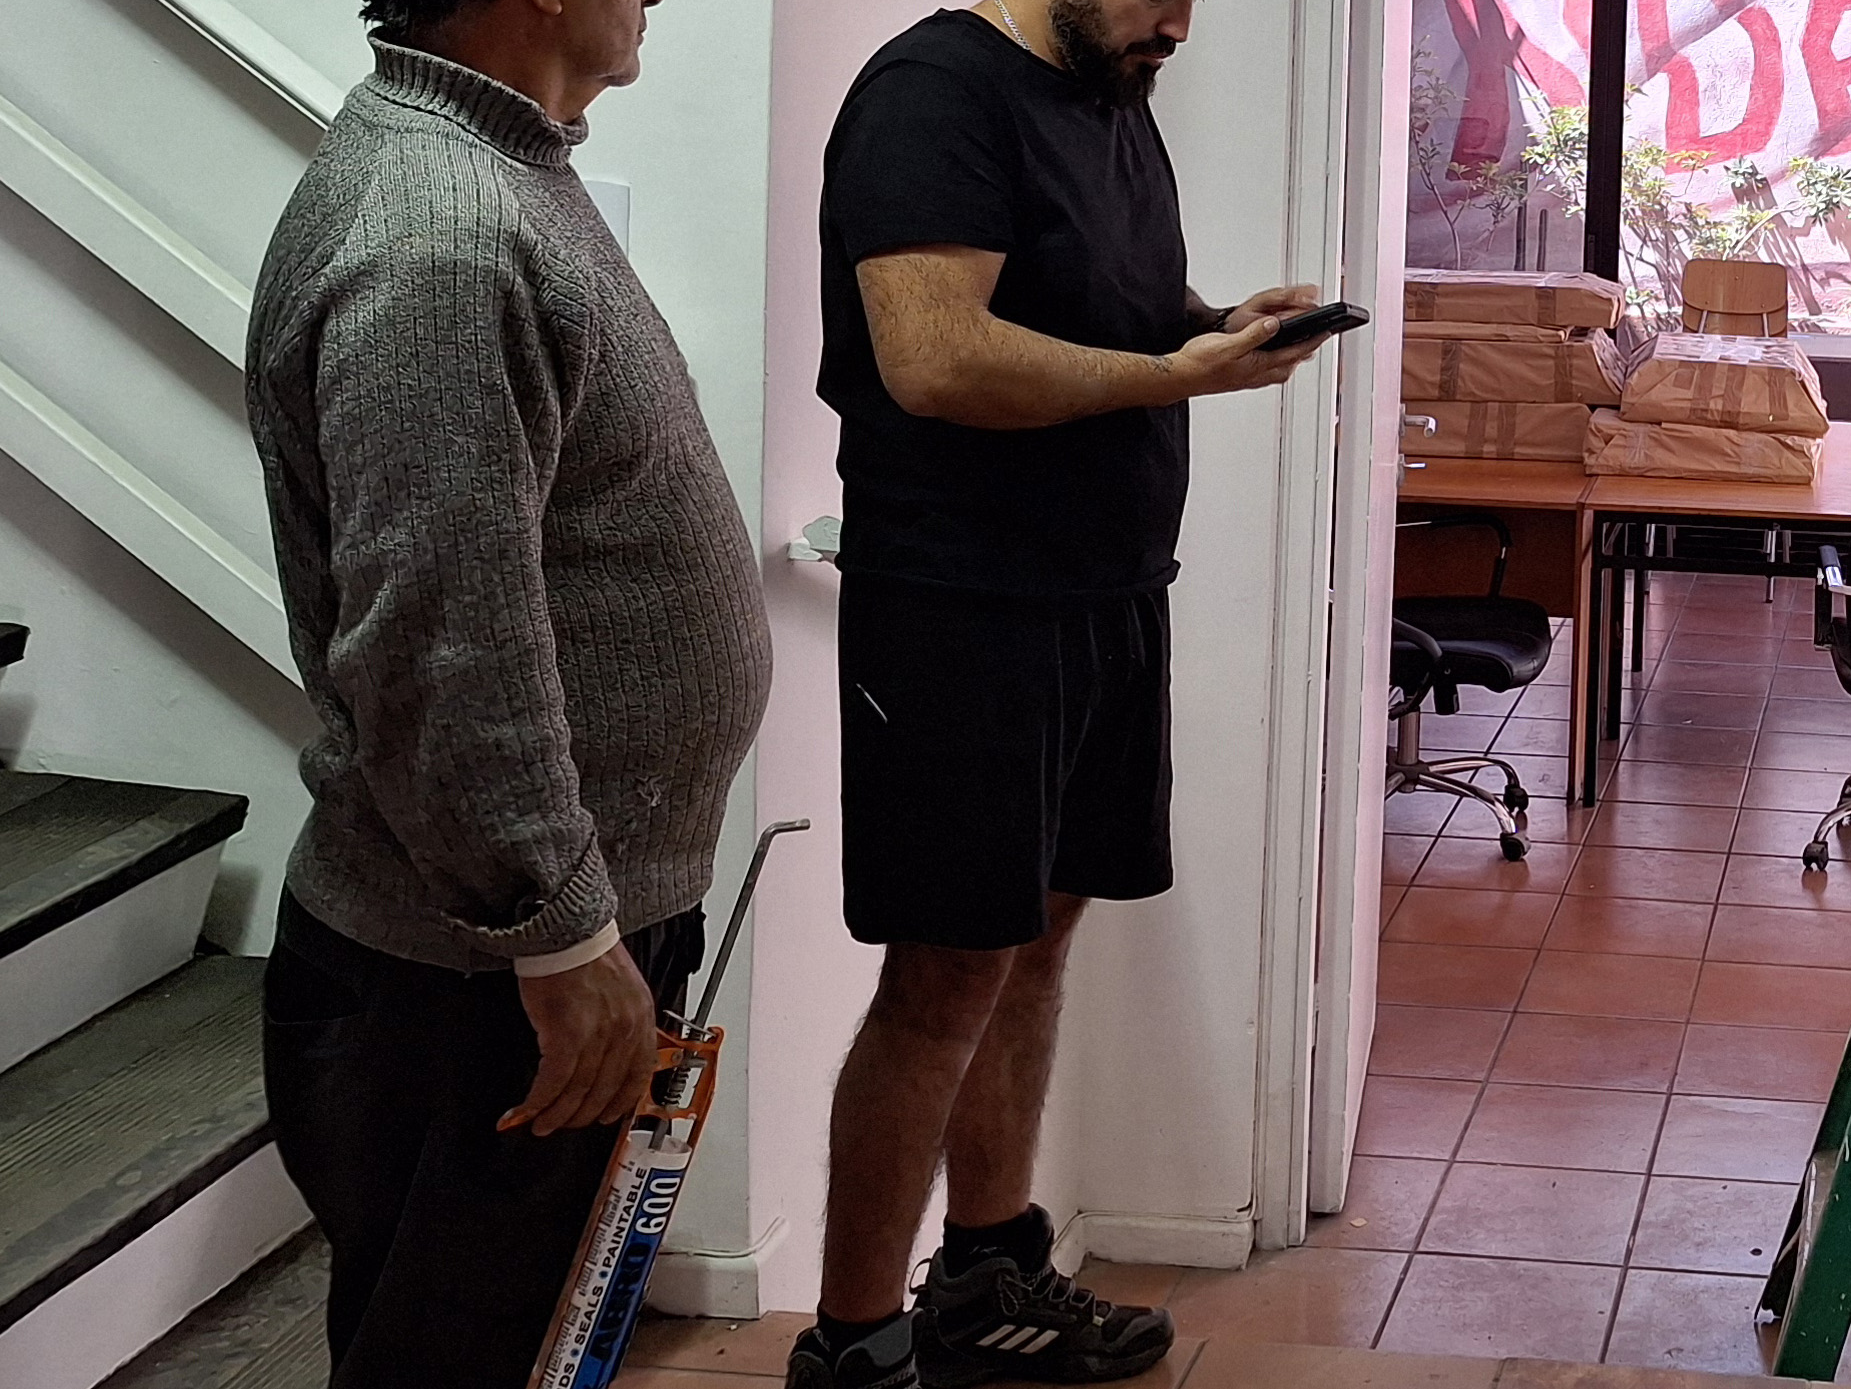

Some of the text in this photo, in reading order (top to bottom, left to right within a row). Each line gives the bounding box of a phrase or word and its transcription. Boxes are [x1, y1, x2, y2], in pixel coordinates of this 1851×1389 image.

[635, 1177, 681, 1234] 600
[557, 1167, 647, 1389] DS SEALS PAINTABLE
